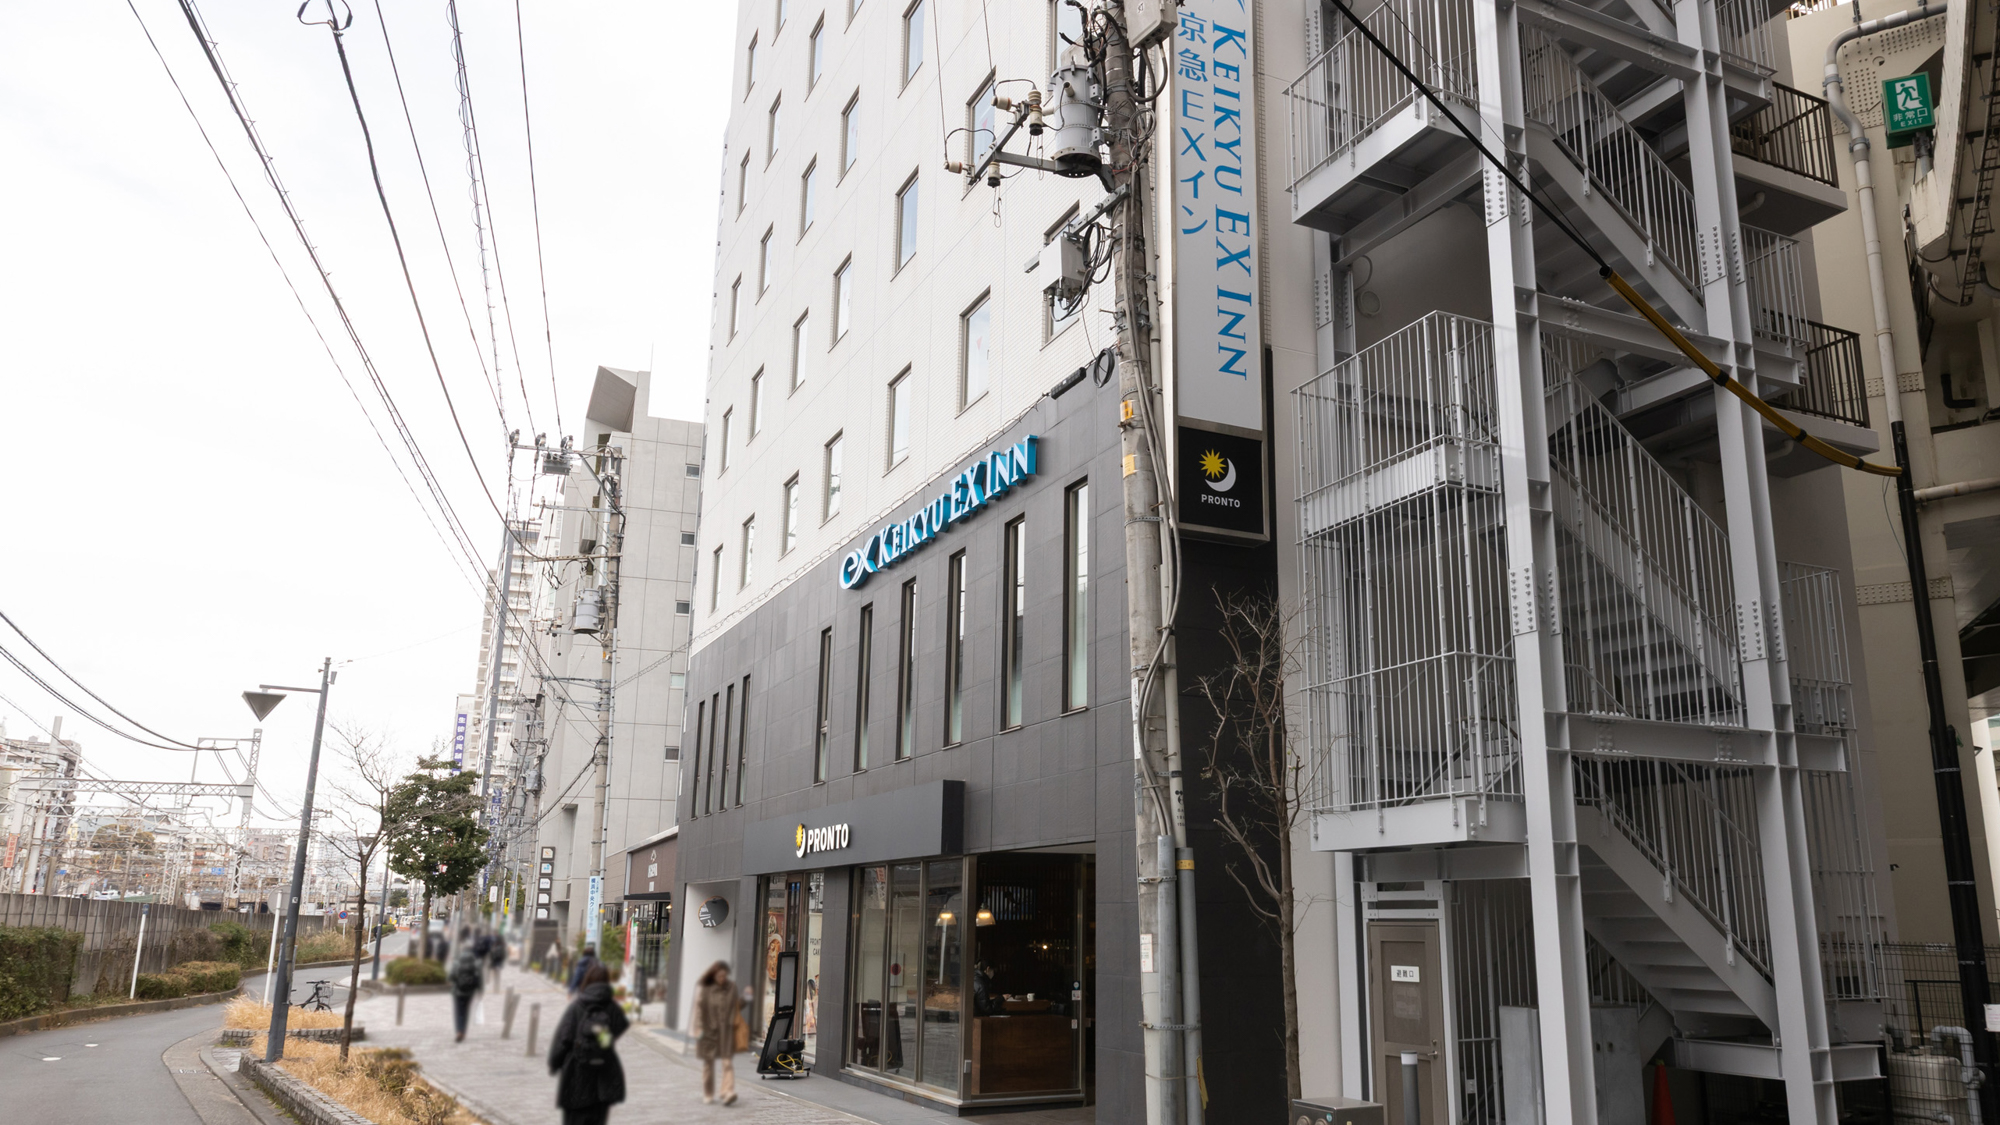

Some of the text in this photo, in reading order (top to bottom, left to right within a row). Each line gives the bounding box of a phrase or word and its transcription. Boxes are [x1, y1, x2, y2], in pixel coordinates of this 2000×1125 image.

[1893, 108, 1928, 122] 非常口
[1900, 118, 1923, 127] EXIT
[1212, 19, 1252, 380] KEIKYU EX INN
[878, 493, 951, 569] KEIKYU
[948, 461, 987, 523] EX
[985, 434, 1038, 500] INN
[1201, 494, 1241, 508] PRONTO
[806, 823, 849, 853] PRONTO
